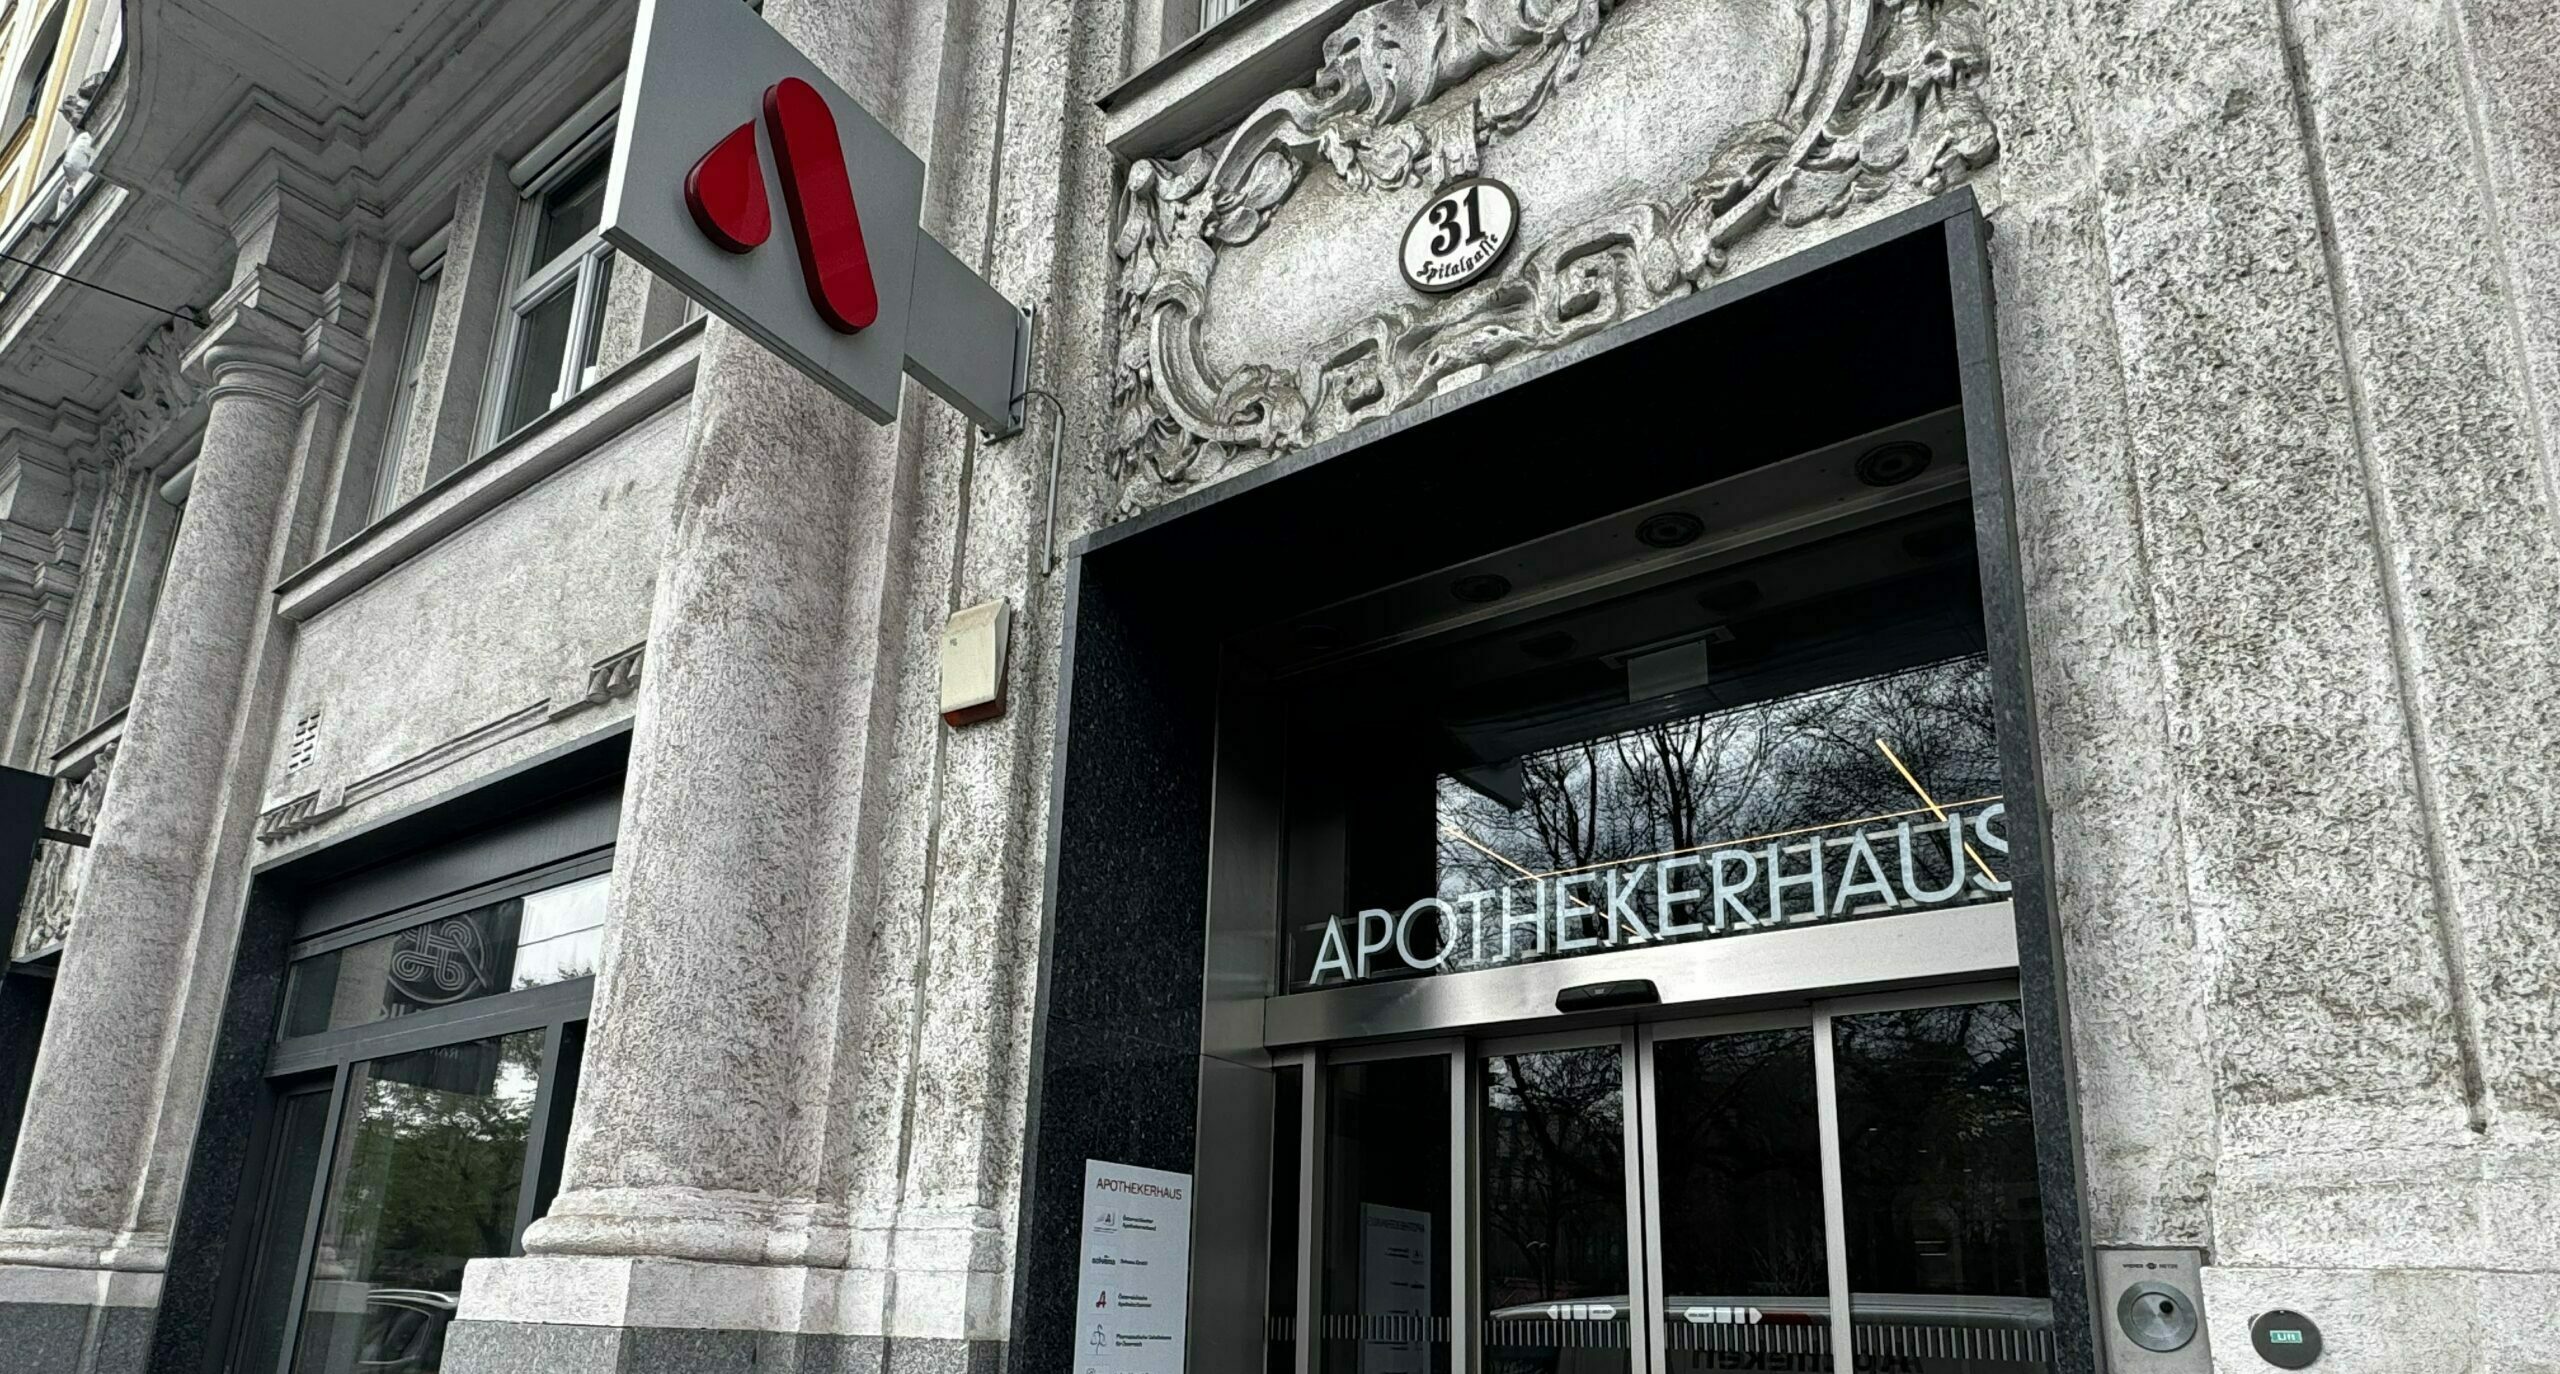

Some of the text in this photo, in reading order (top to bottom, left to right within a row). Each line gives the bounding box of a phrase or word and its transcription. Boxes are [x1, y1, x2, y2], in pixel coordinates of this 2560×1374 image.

[1429, 186, 1488, 257] 31
[1309, 803, 2012, 985] APOTHEKERHAUS
[1096, 1177, 1182, 1201] APOTHEKERHAUS
